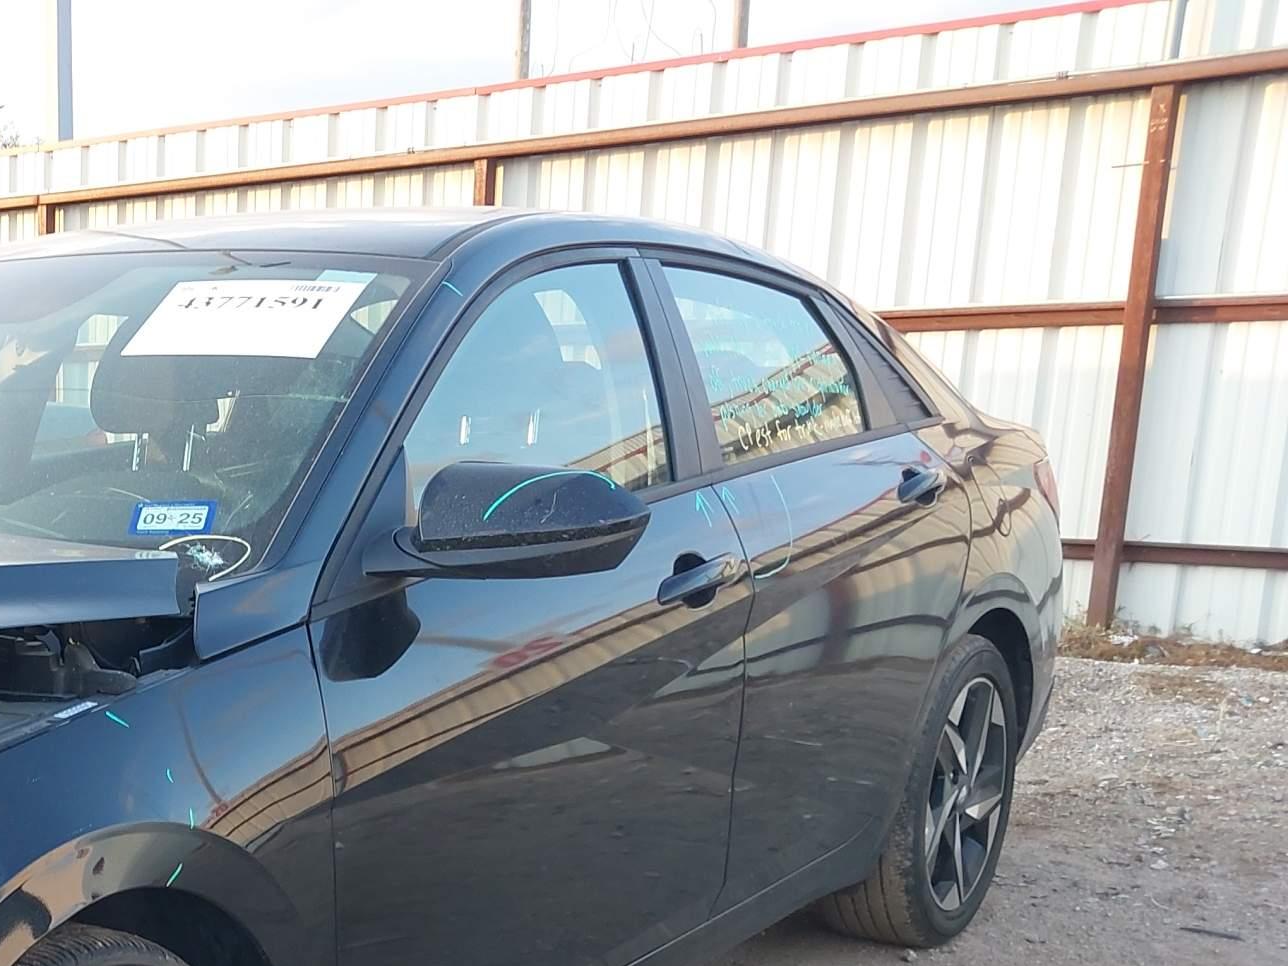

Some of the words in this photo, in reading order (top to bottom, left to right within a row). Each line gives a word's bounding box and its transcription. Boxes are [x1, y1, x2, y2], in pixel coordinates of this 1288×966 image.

[177, 296, 324, 310] 43771591
[143, 512, 168, 525] 09
[177, 512, 204, 525] 25
